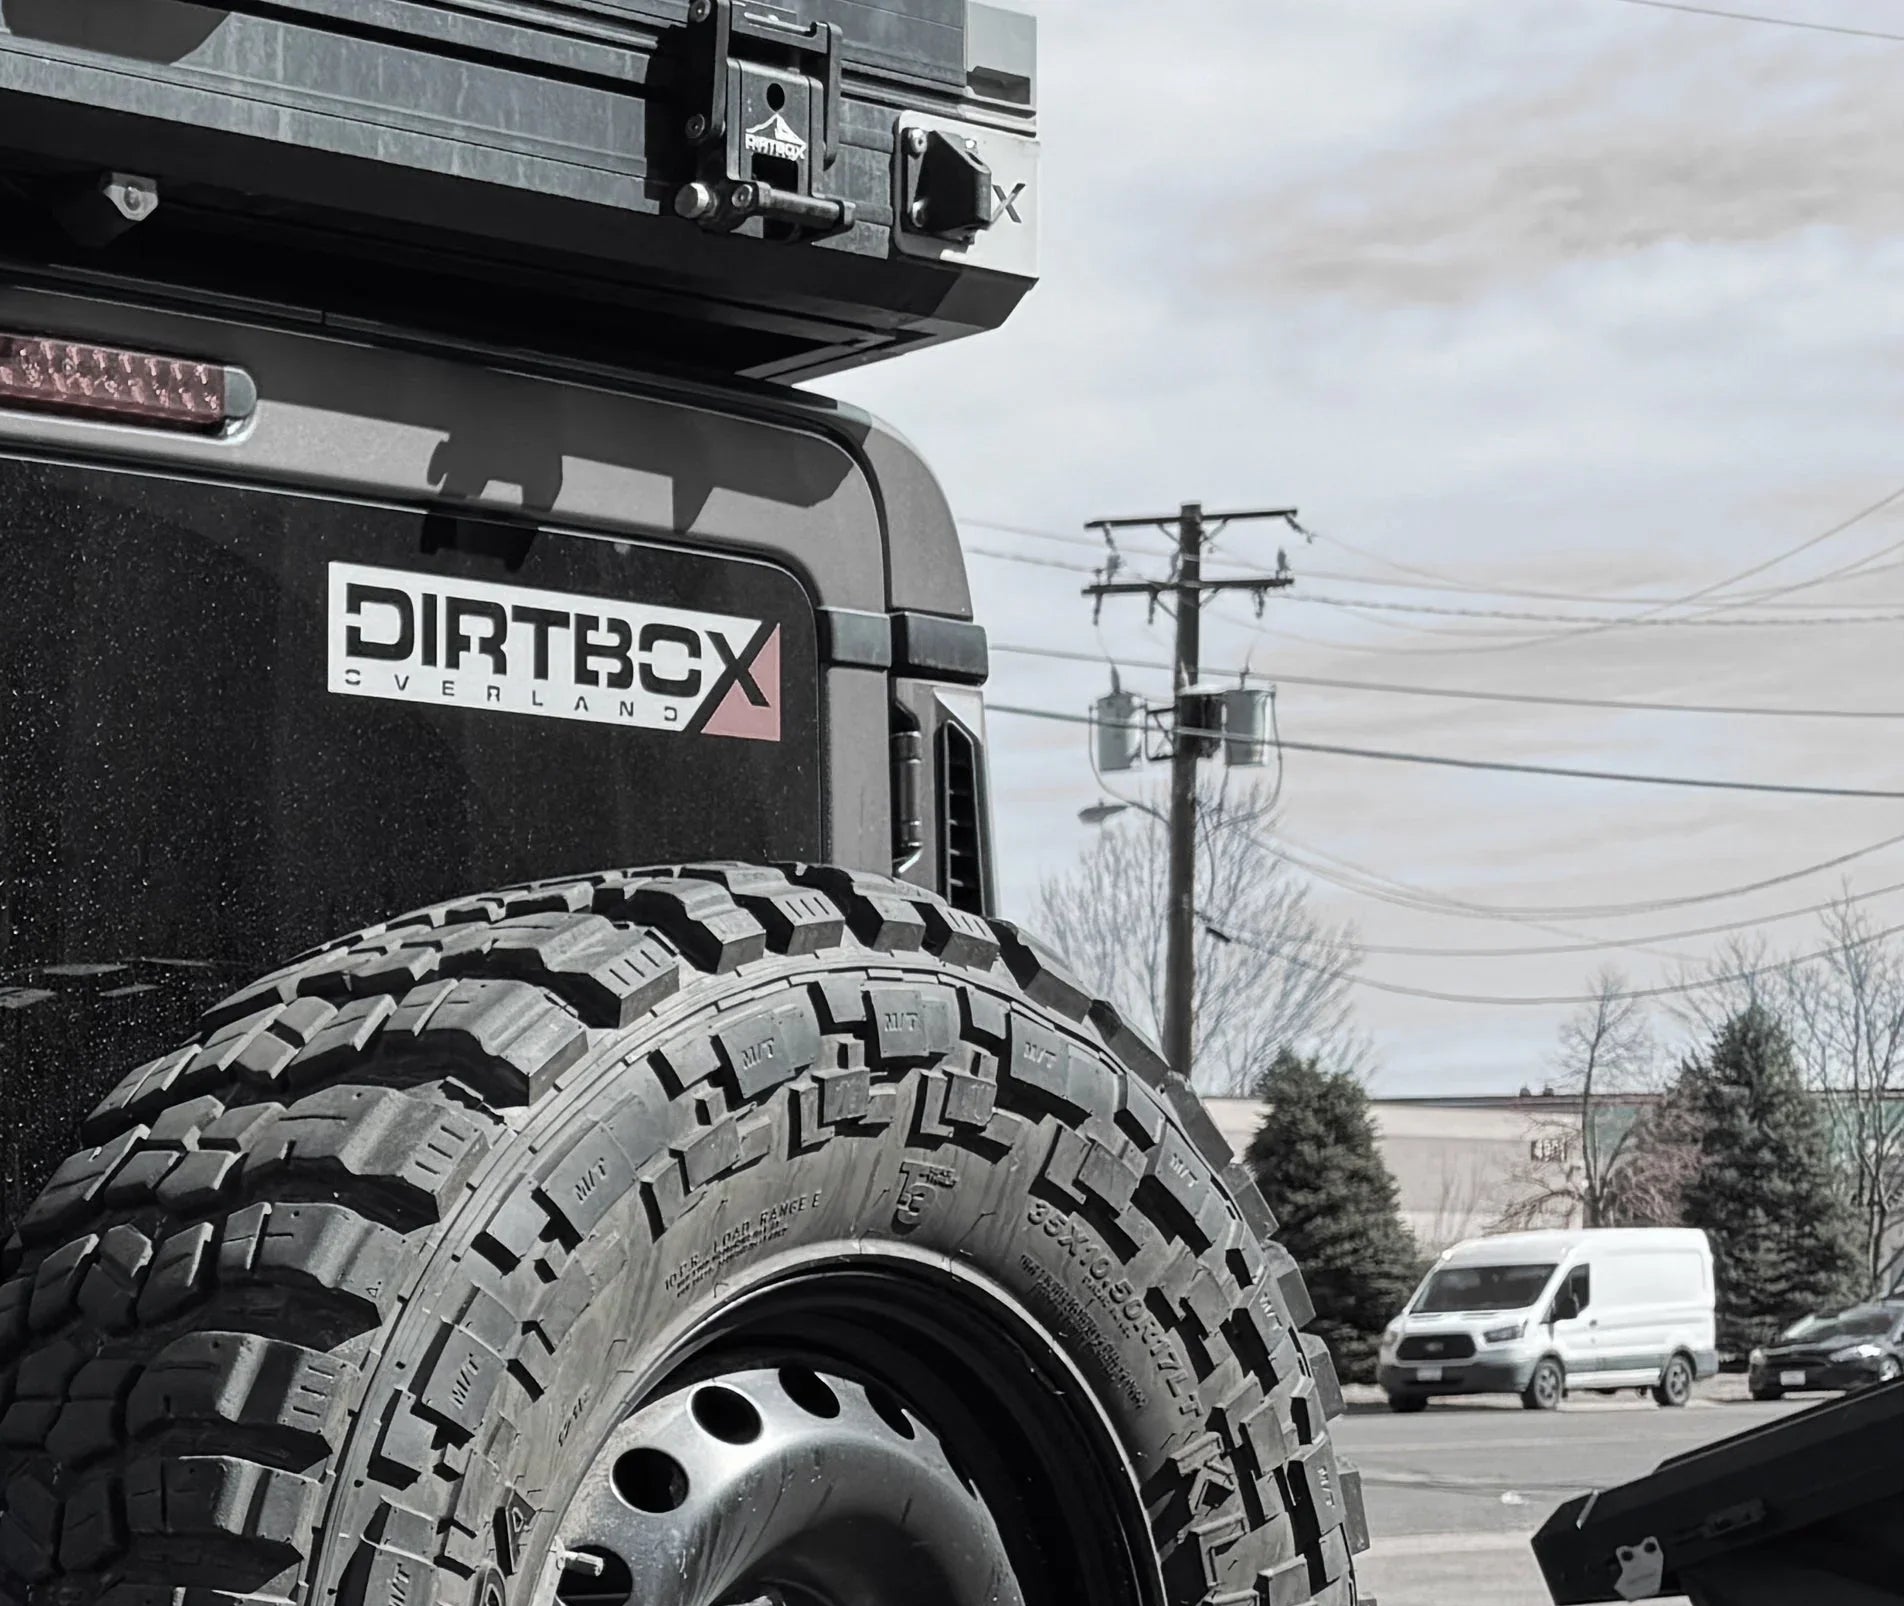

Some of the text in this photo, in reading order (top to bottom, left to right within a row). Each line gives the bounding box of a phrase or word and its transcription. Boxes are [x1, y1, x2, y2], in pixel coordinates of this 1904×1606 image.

[344, 581, 779, 725] DIRTBOX
[344, 669, 678, 723] OVERLAND
[741, 1036, 775, 1071] M/T
[574, 1156, 607, 1206] M/T
[449, 1351, 478, 1411] M/T
